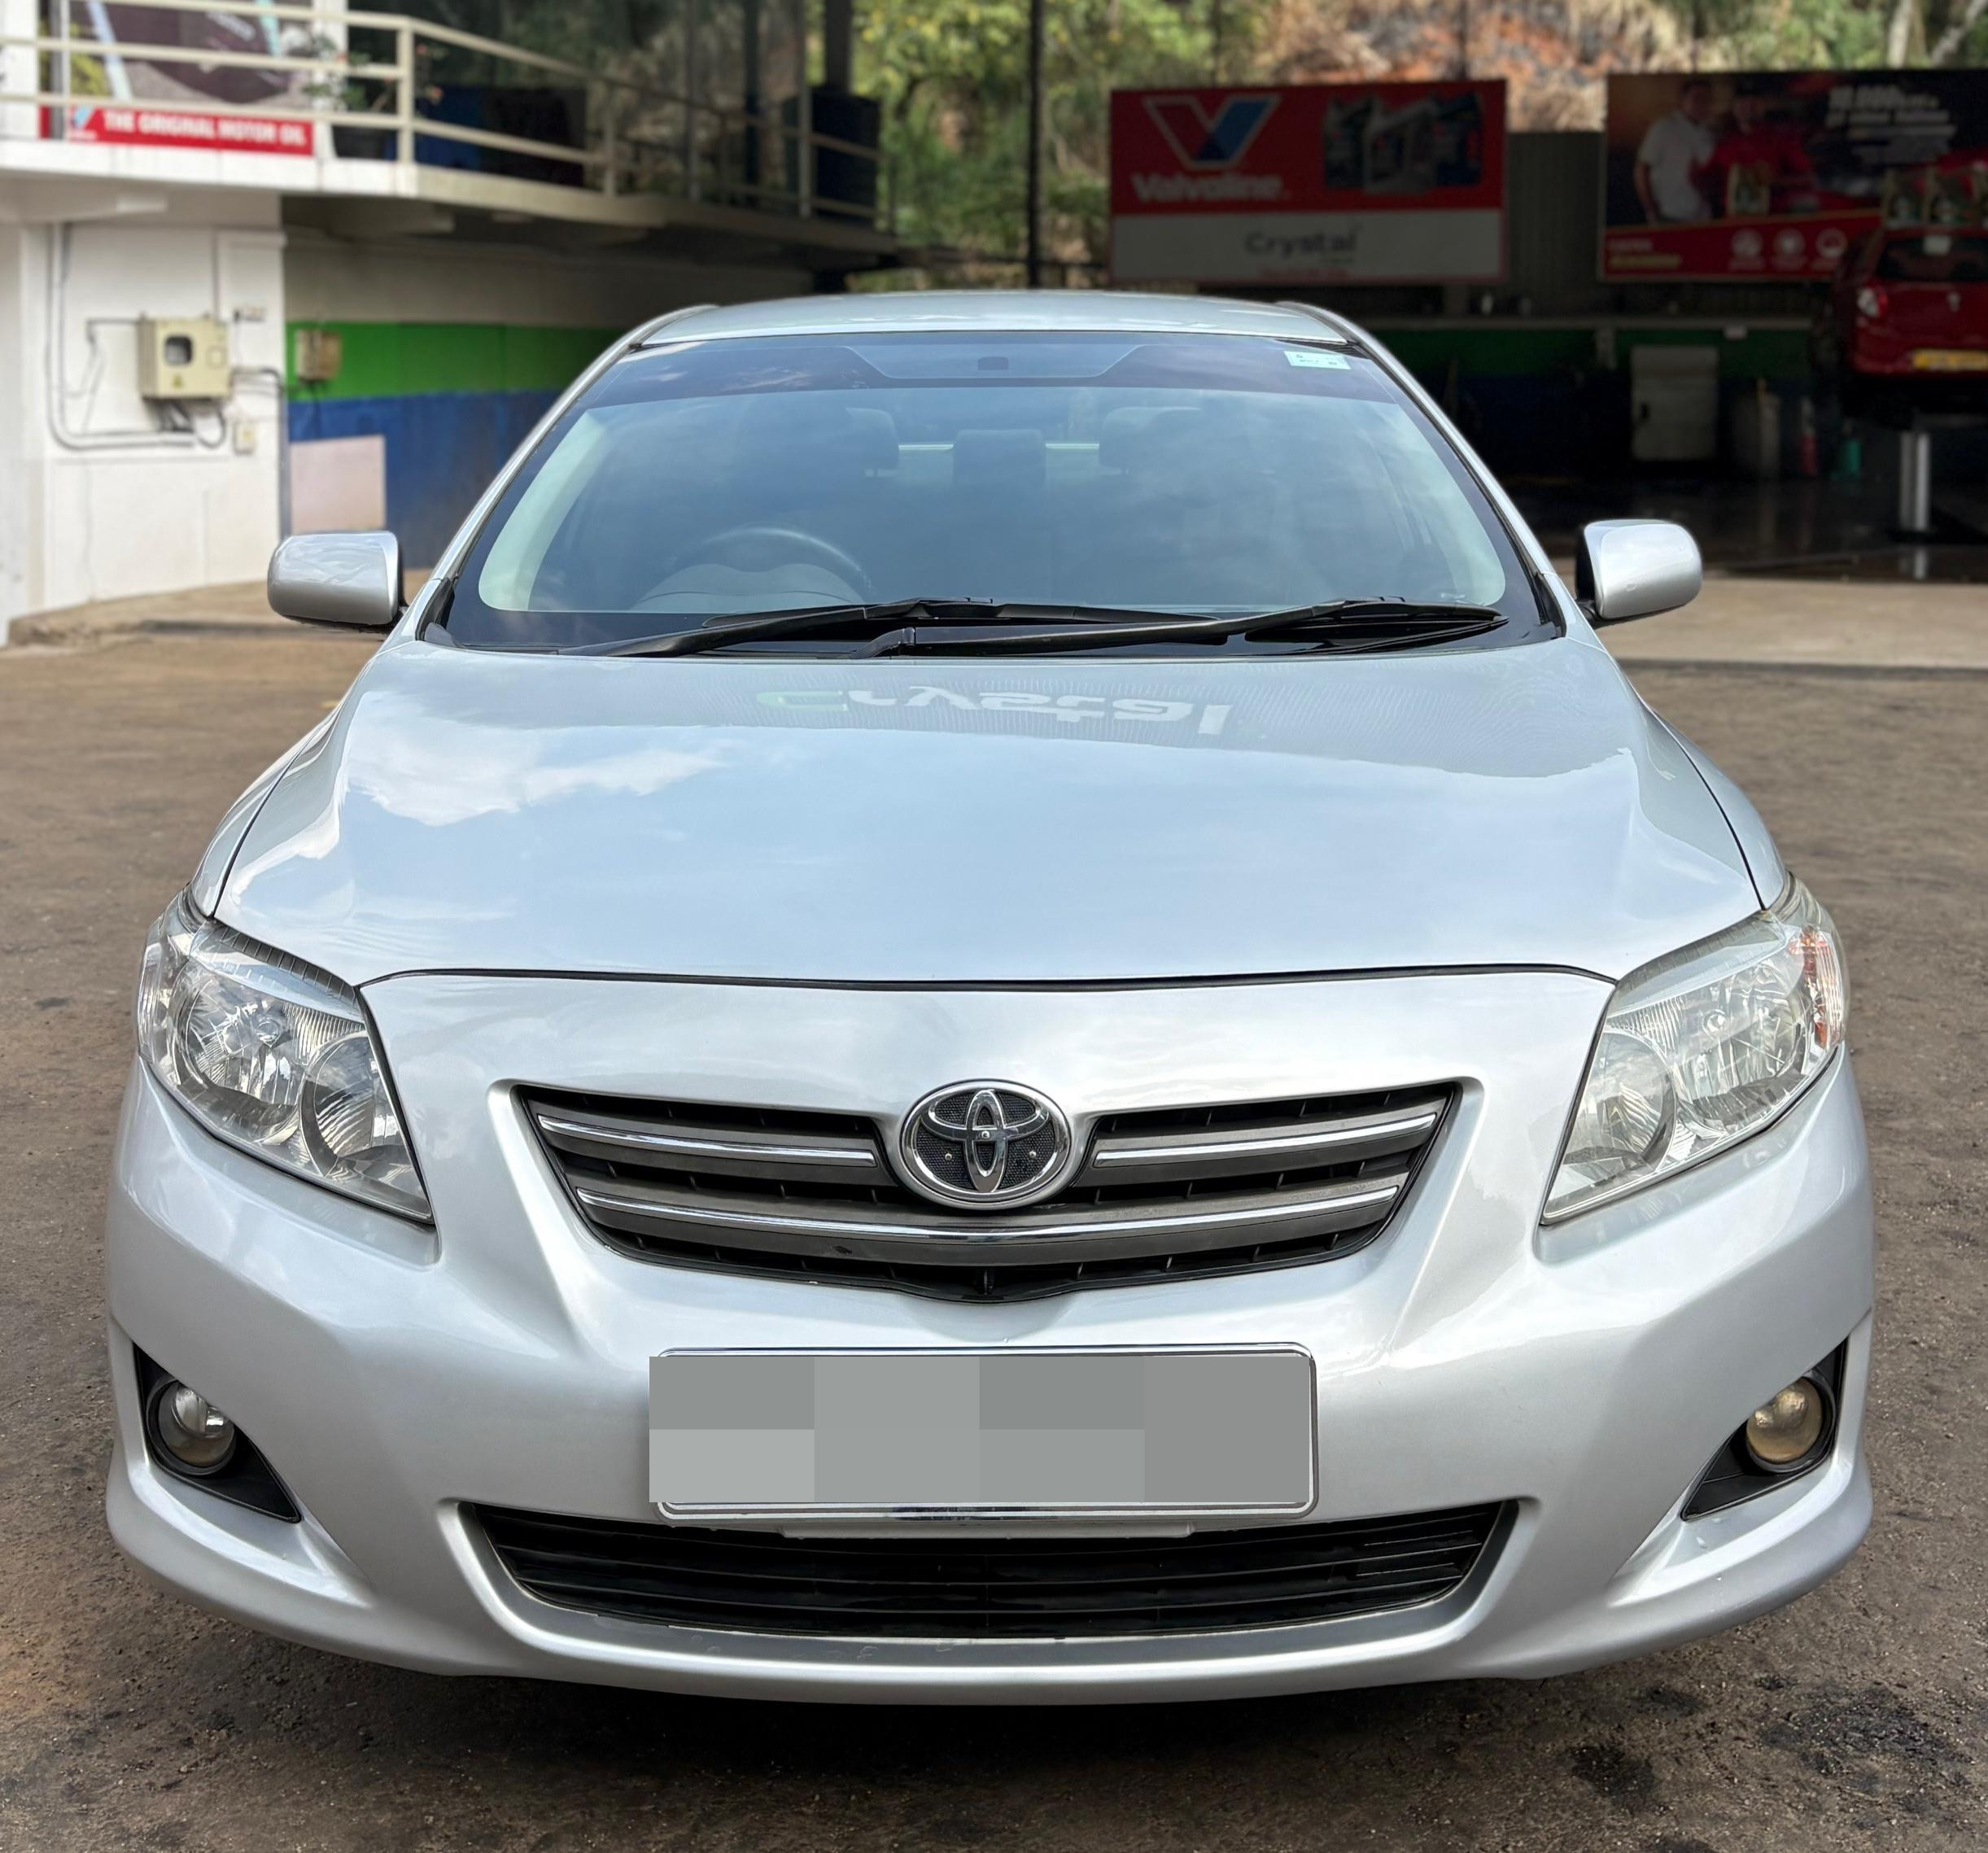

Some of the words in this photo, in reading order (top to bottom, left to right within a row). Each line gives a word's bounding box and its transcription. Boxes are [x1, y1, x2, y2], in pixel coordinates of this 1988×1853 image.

[105, 111, 134, 133] THE
[138, 113, 215, 139] ORIGINAL
[218, 121, 276, 143] MOTOR
[280, 124, 306, 146] OIL
[1130, 172, 1281, 202] Valvoline
[1245, 229, 1355, 259] Crystal
